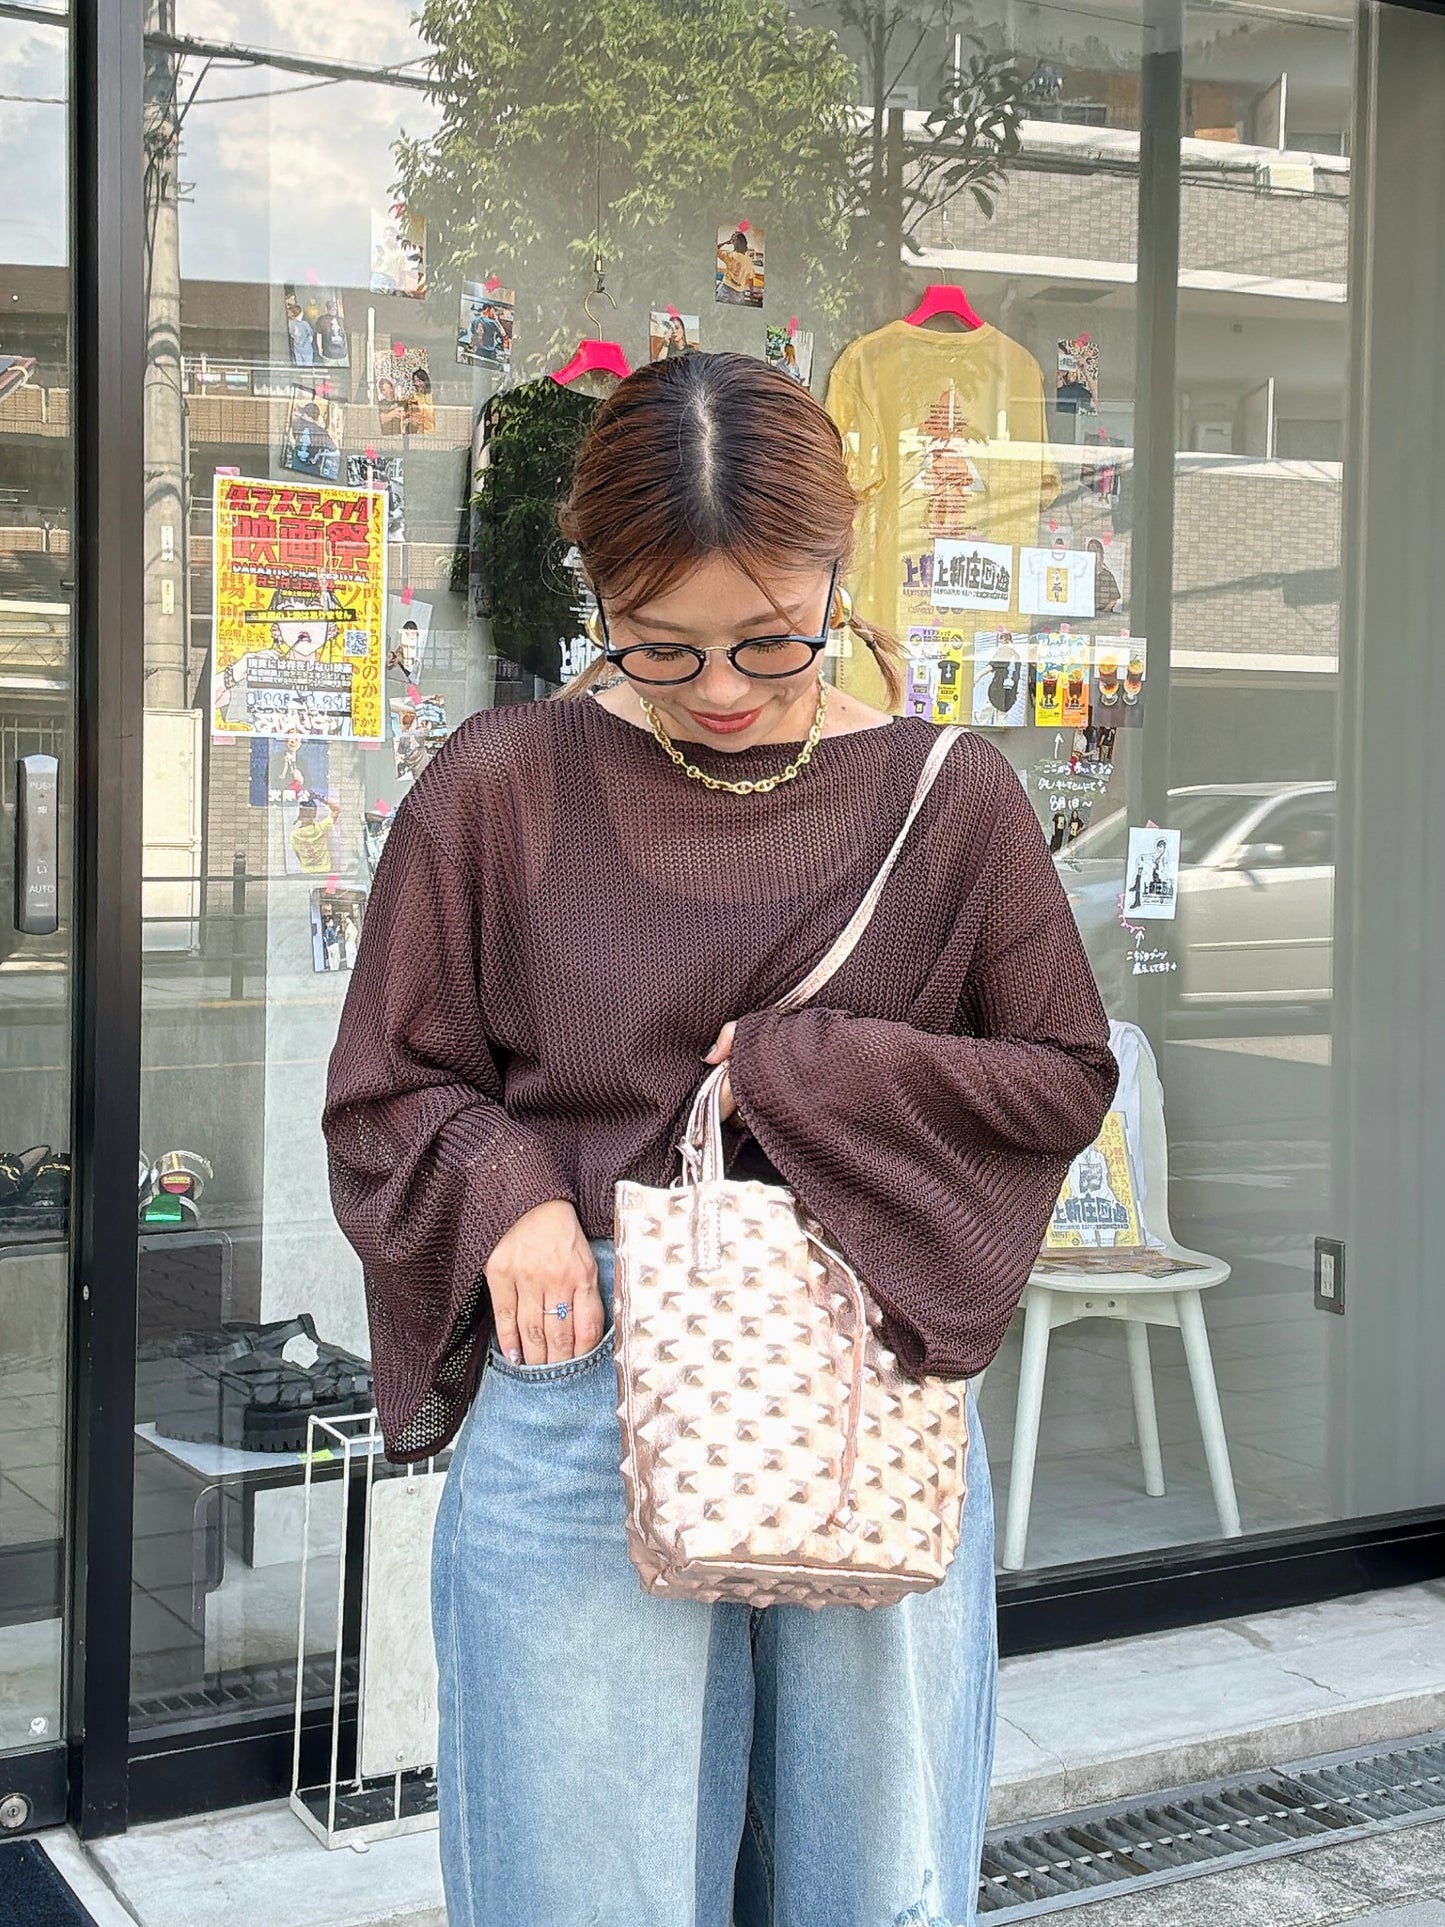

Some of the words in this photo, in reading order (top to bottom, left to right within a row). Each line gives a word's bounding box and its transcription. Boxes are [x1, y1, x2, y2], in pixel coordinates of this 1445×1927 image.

[232, 514, 370, 569] 映画祭
[292, 565, 318, 579] FILM
[319, 568, 370, 583] FESTIVAL
[934, 550, 1010, 592] 上新庄回遊
[29, 885, 55, 894] AUTO
[1053, 1193, 1128, 1223] 上新庄回遊
